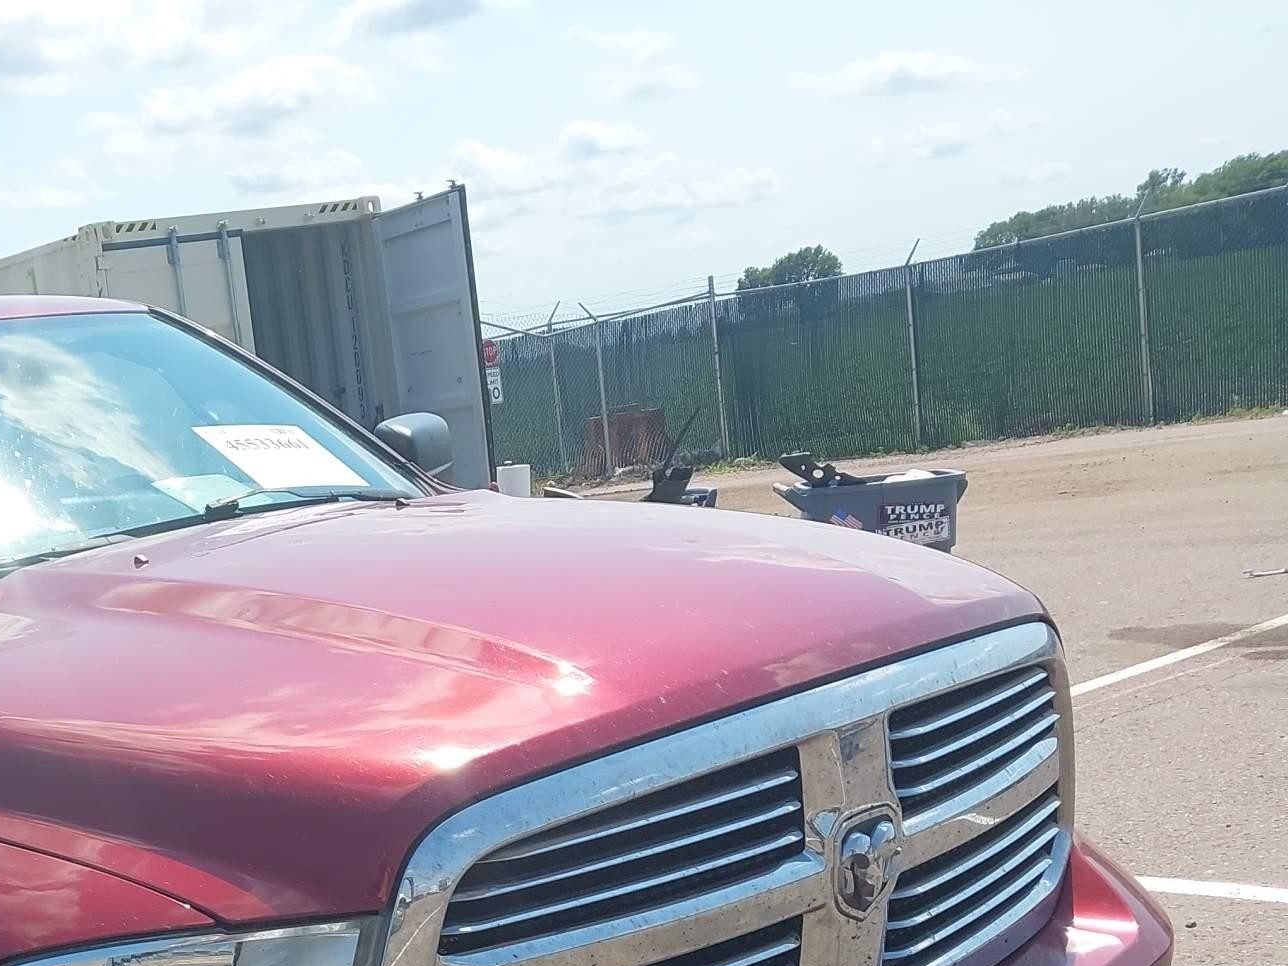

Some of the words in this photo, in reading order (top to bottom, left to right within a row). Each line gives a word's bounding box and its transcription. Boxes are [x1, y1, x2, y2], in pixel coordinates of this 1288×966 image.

[226, 438, 309, 450] 45533661
[885, 504, 945, 514] TRUMP
[889, 512, 941, 520] PENCE
[884, 520, 945, 537] TRUMP
